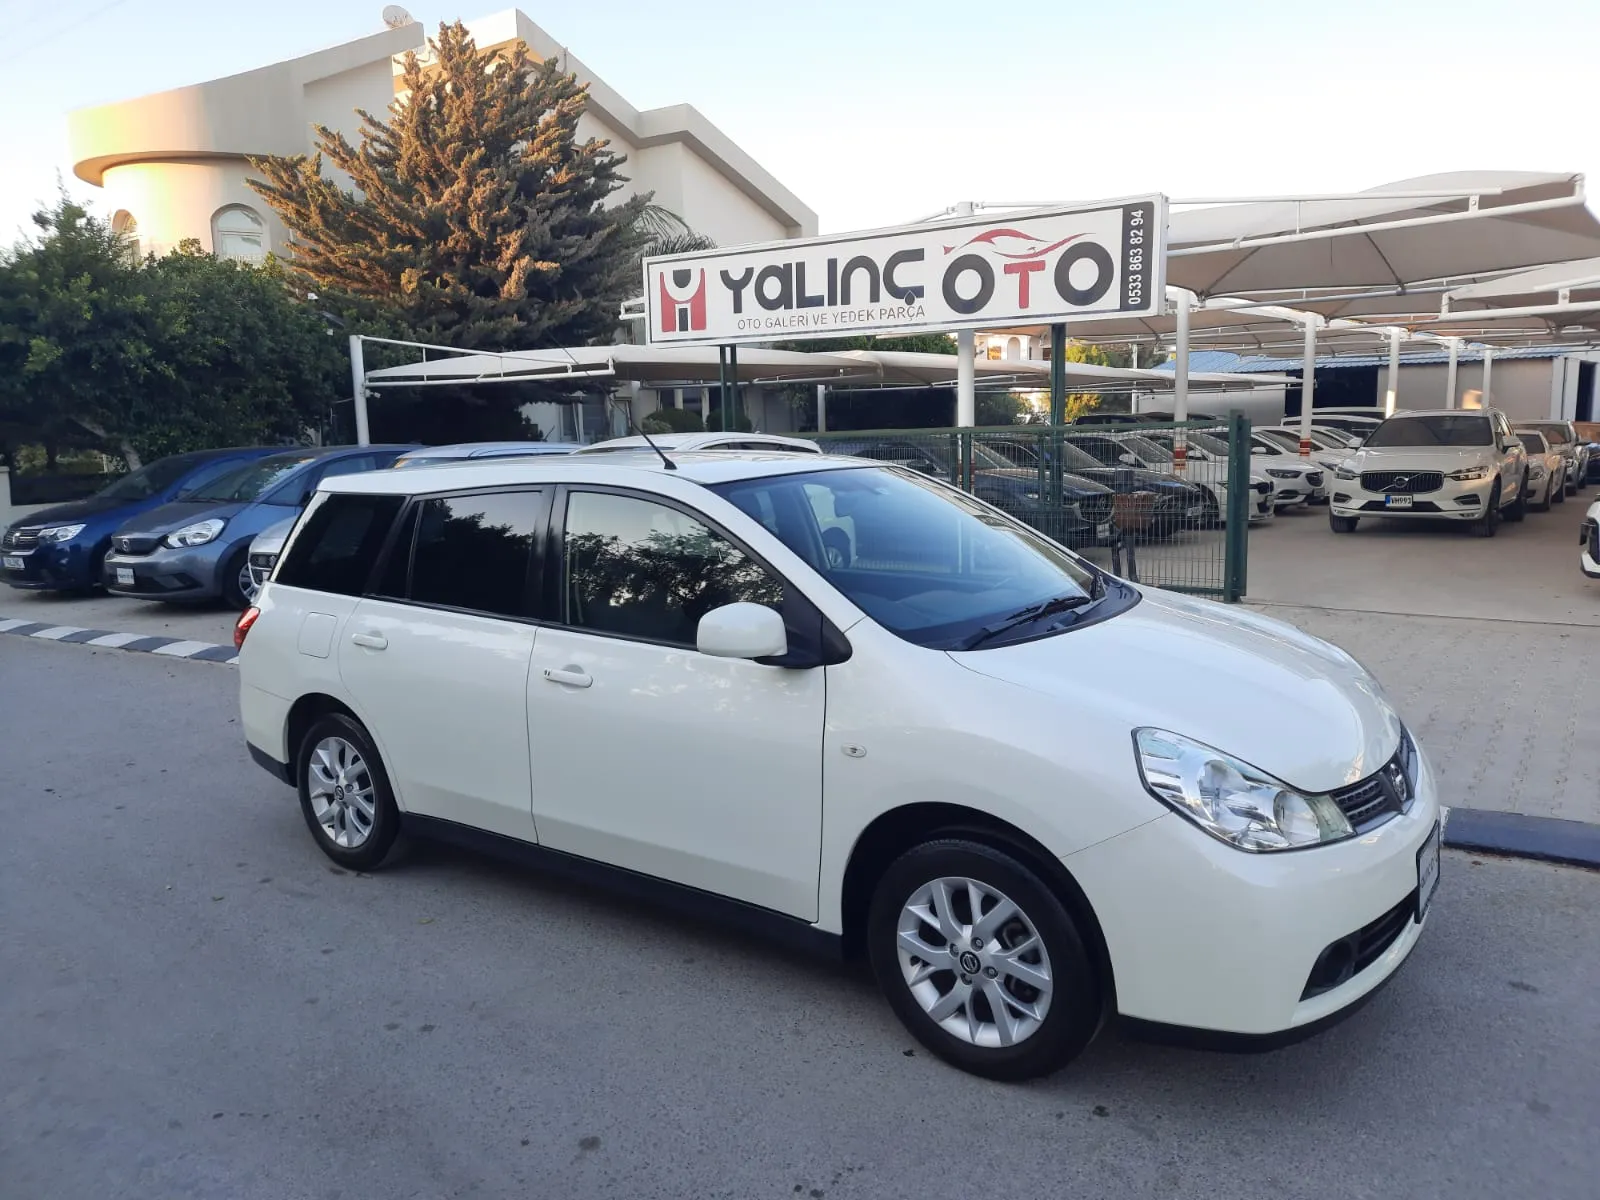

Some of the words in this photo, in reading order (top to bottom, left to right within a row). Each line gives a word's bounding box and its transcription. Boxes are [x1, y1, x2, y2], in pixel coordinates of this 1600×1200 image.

[1130, 209, 1144, 226] 94
[1130, 228, 1143, 245] 82
[1129, 248, 1143, 271] 863
[942, 241, 1114, 315] OTO
[1128, 274, 1142, 305] 0533
[737, 319, 762, 331] OTO
[812, 313, 829, 327] VE
[832, 308, 876, 325] YEDEK
[879, 304, 926, 322] PARÇA
